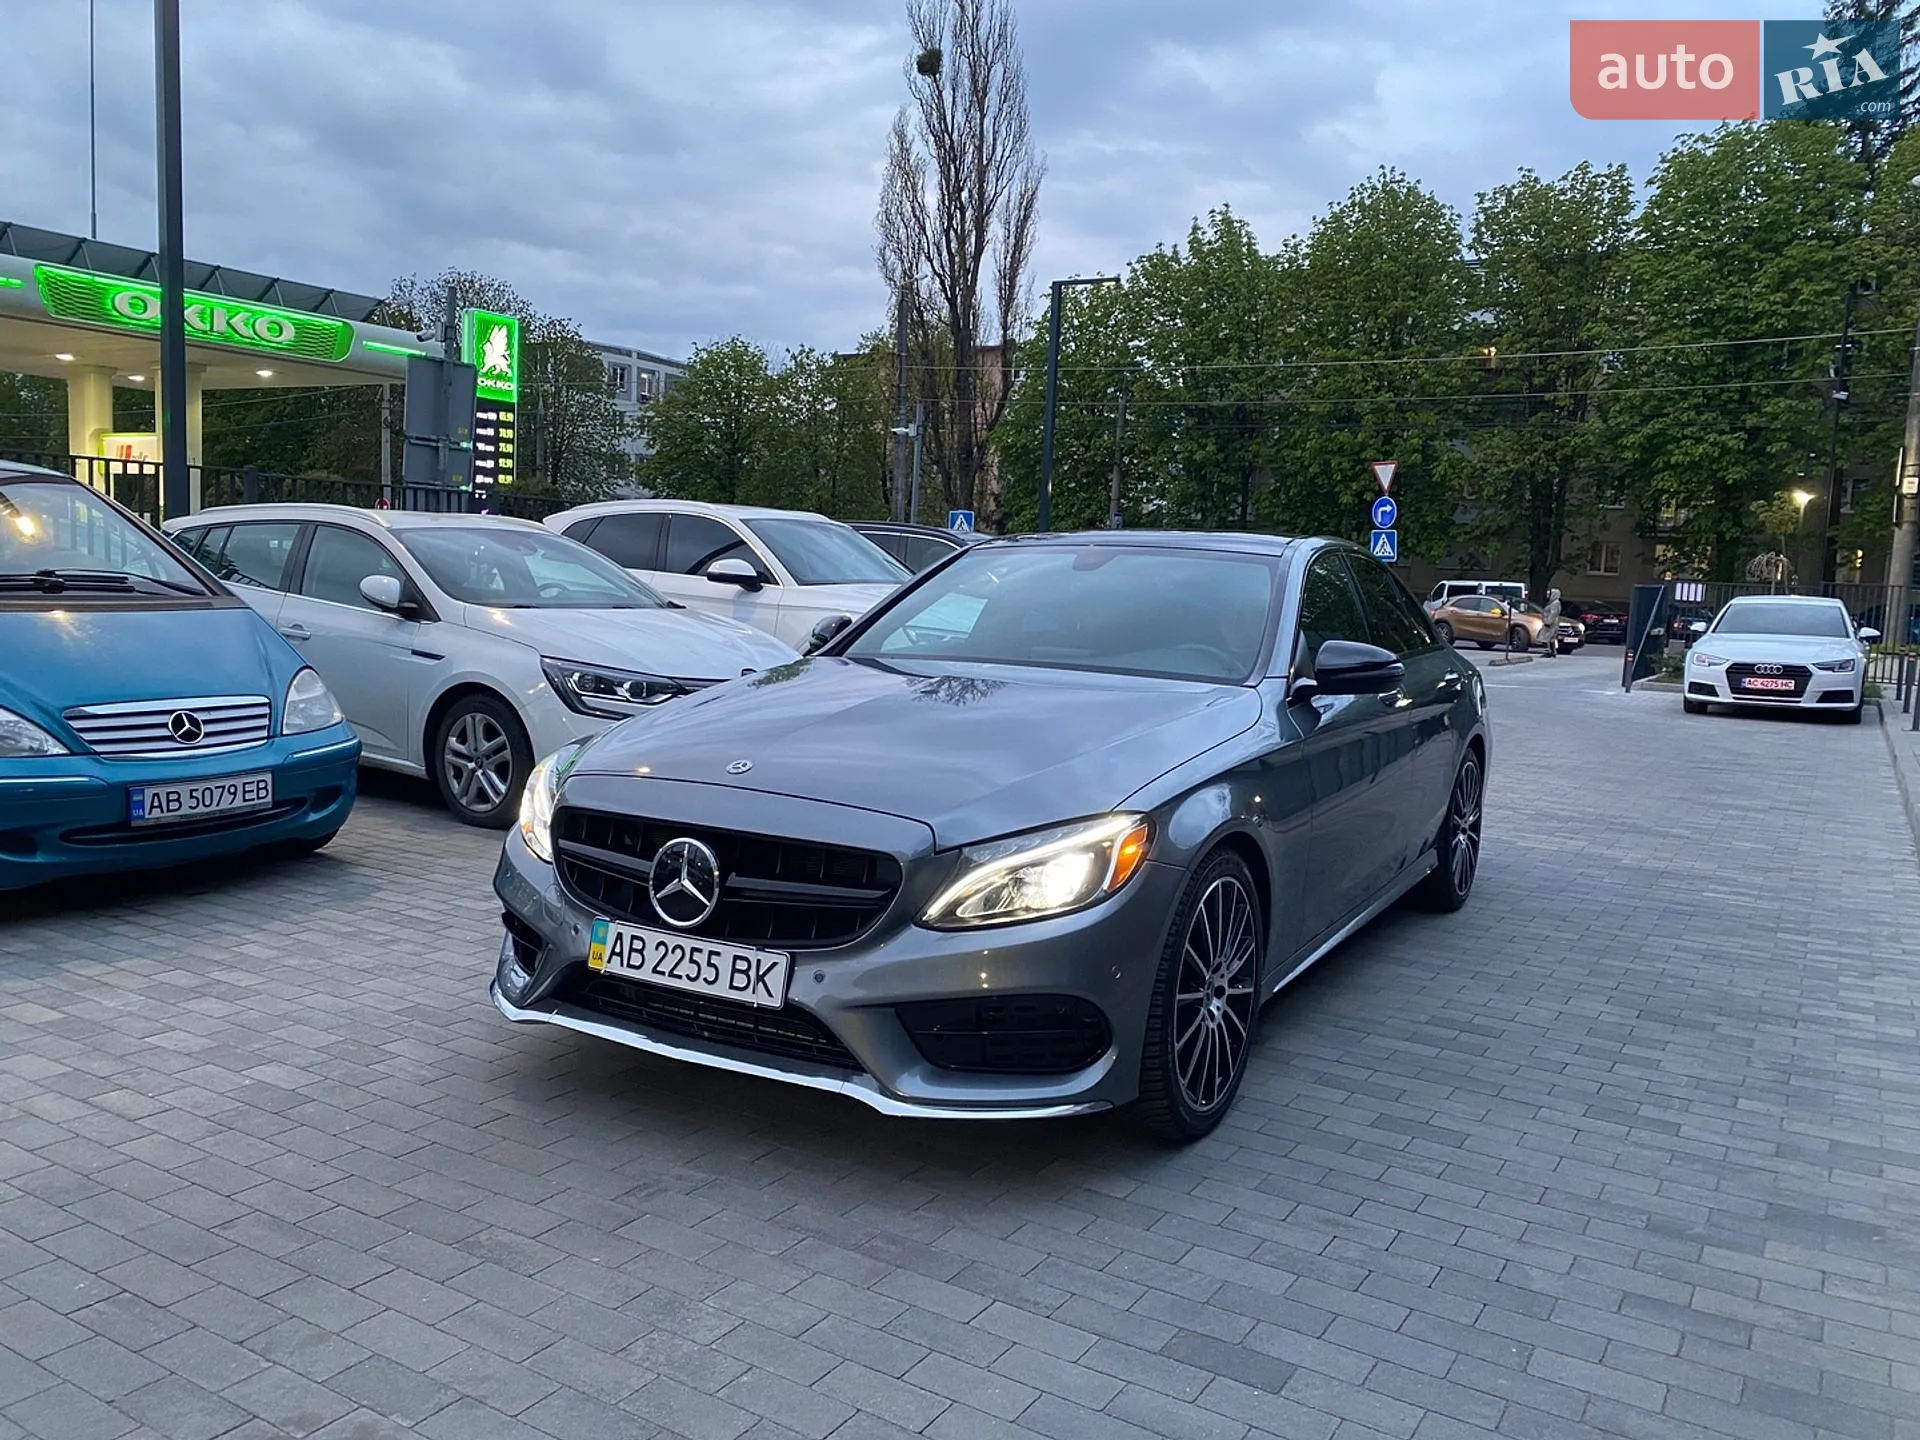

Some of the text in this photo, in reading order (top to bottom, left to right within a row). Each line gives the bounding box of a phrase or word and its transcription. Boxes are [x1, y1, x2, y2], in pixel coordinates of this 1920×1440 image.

[477, 377, 514, 390] OKKO
[1747, 679, 1759, 687] AC
[1760, 680, 1779, 688] 4275
[148, 779, 269, 815] AB 5079 EB
[132, 809, 144, 817] UA
[592, 951, 603, 961] UA
[607, 931, 779, 998] AB 2255 BK
